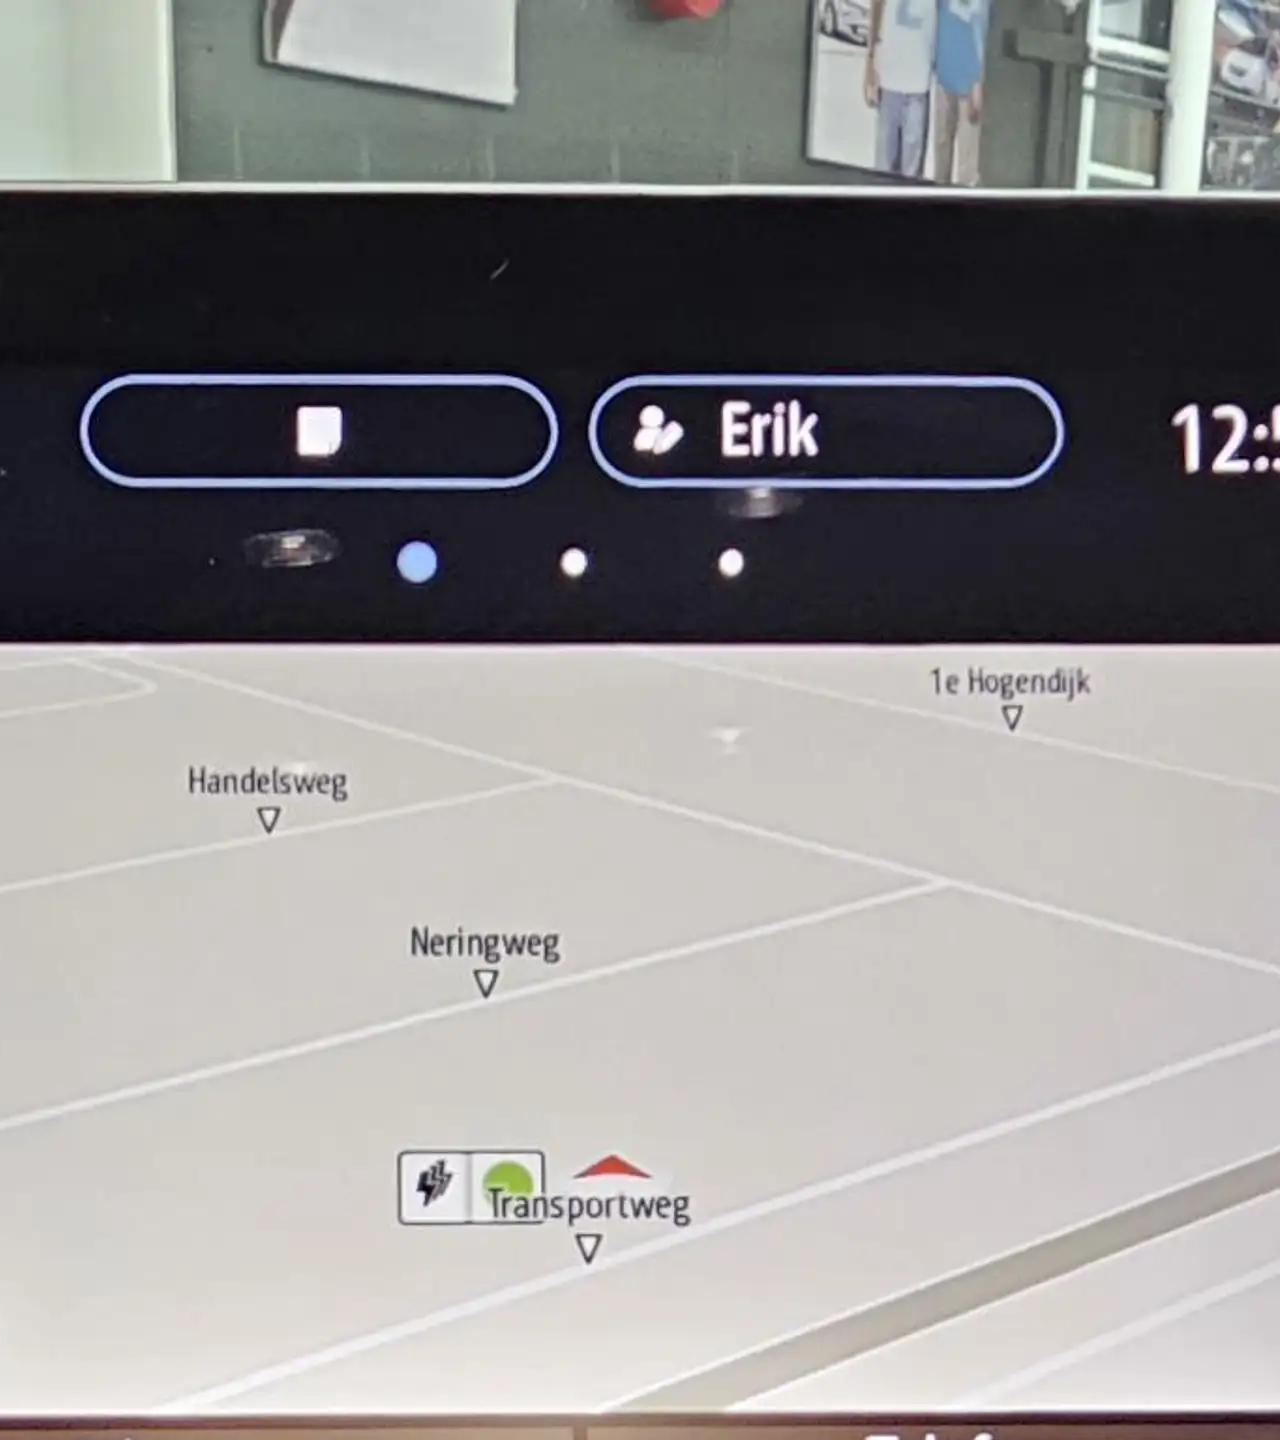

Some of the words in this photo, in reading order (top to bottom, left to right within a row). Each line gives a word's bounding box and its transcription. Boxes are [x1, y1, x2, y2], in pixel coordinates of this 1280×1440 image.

[721, 399, 820, 459] Erik
[930, 667, 960, 694] 1e
[968, 667, 1092, 702] Hogendijk
[188, 765, 349, 802] Handelsweg
[411, 925, 561, 964] Neringweg
[488, 1187, 691, 1227] Transportweg
